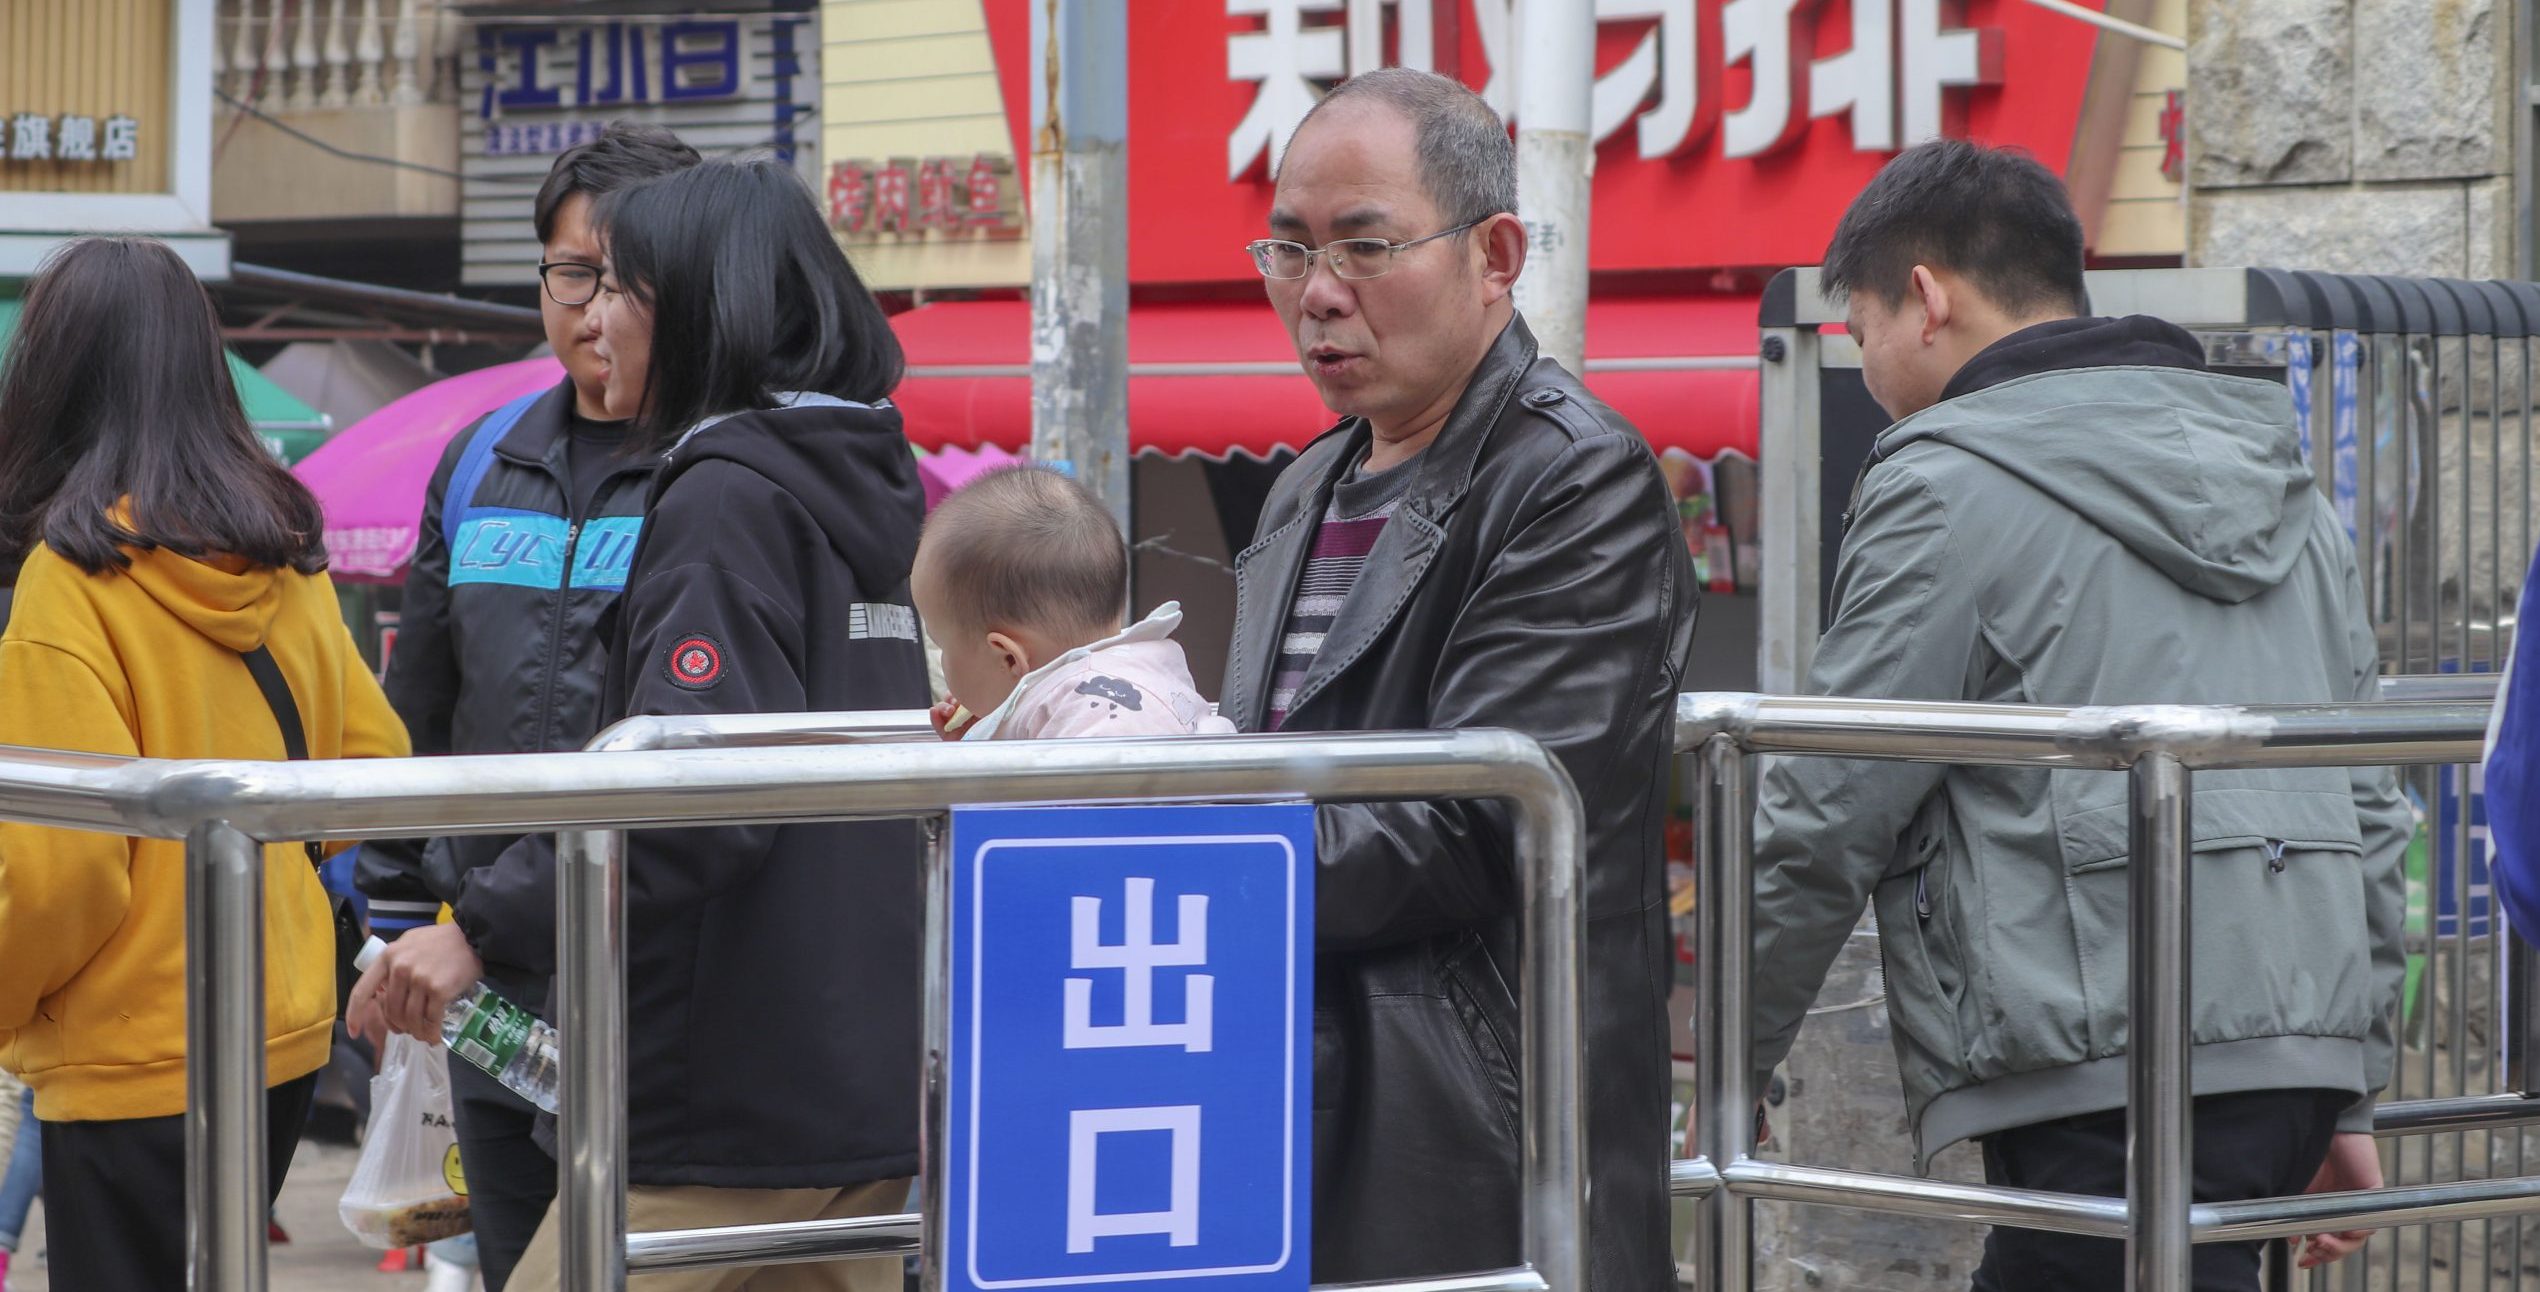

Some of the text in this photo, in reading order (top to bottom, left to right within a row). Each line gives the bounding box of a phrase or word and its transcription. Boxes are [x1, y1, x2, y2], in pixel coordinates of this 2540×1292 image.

[476, 19, 739, 119] 江小白
[0, 112, 137, 160] 旗舰店
[1063, 877, 1214, 1254] 出口
